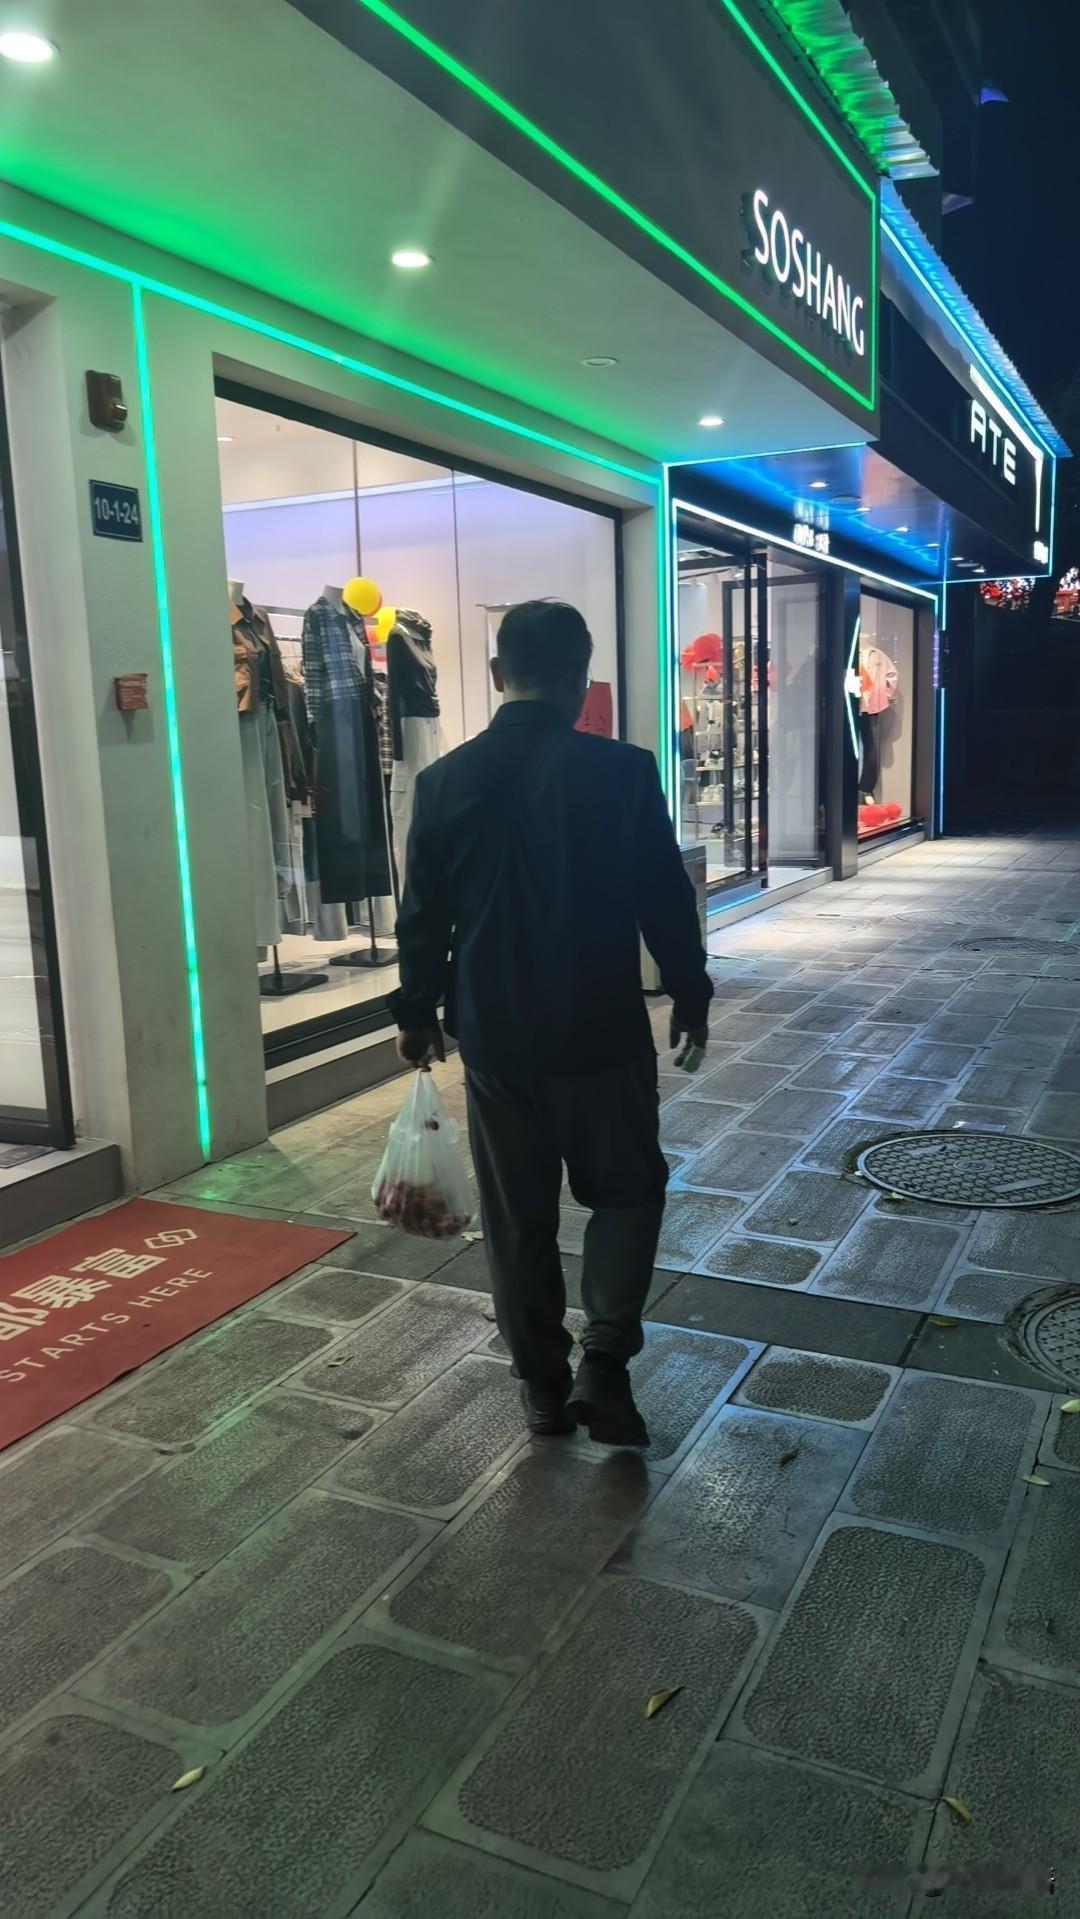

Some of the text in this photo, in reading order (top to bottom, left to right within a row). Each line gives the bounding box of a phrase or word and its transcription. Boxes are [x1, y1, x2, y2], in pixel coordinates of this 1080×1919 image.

[753, 189, 866, 357] SOSHANG
[94, 496, 140, 526] 10-1-24
[0, 1267, 214, 1383] STARTS HERE
